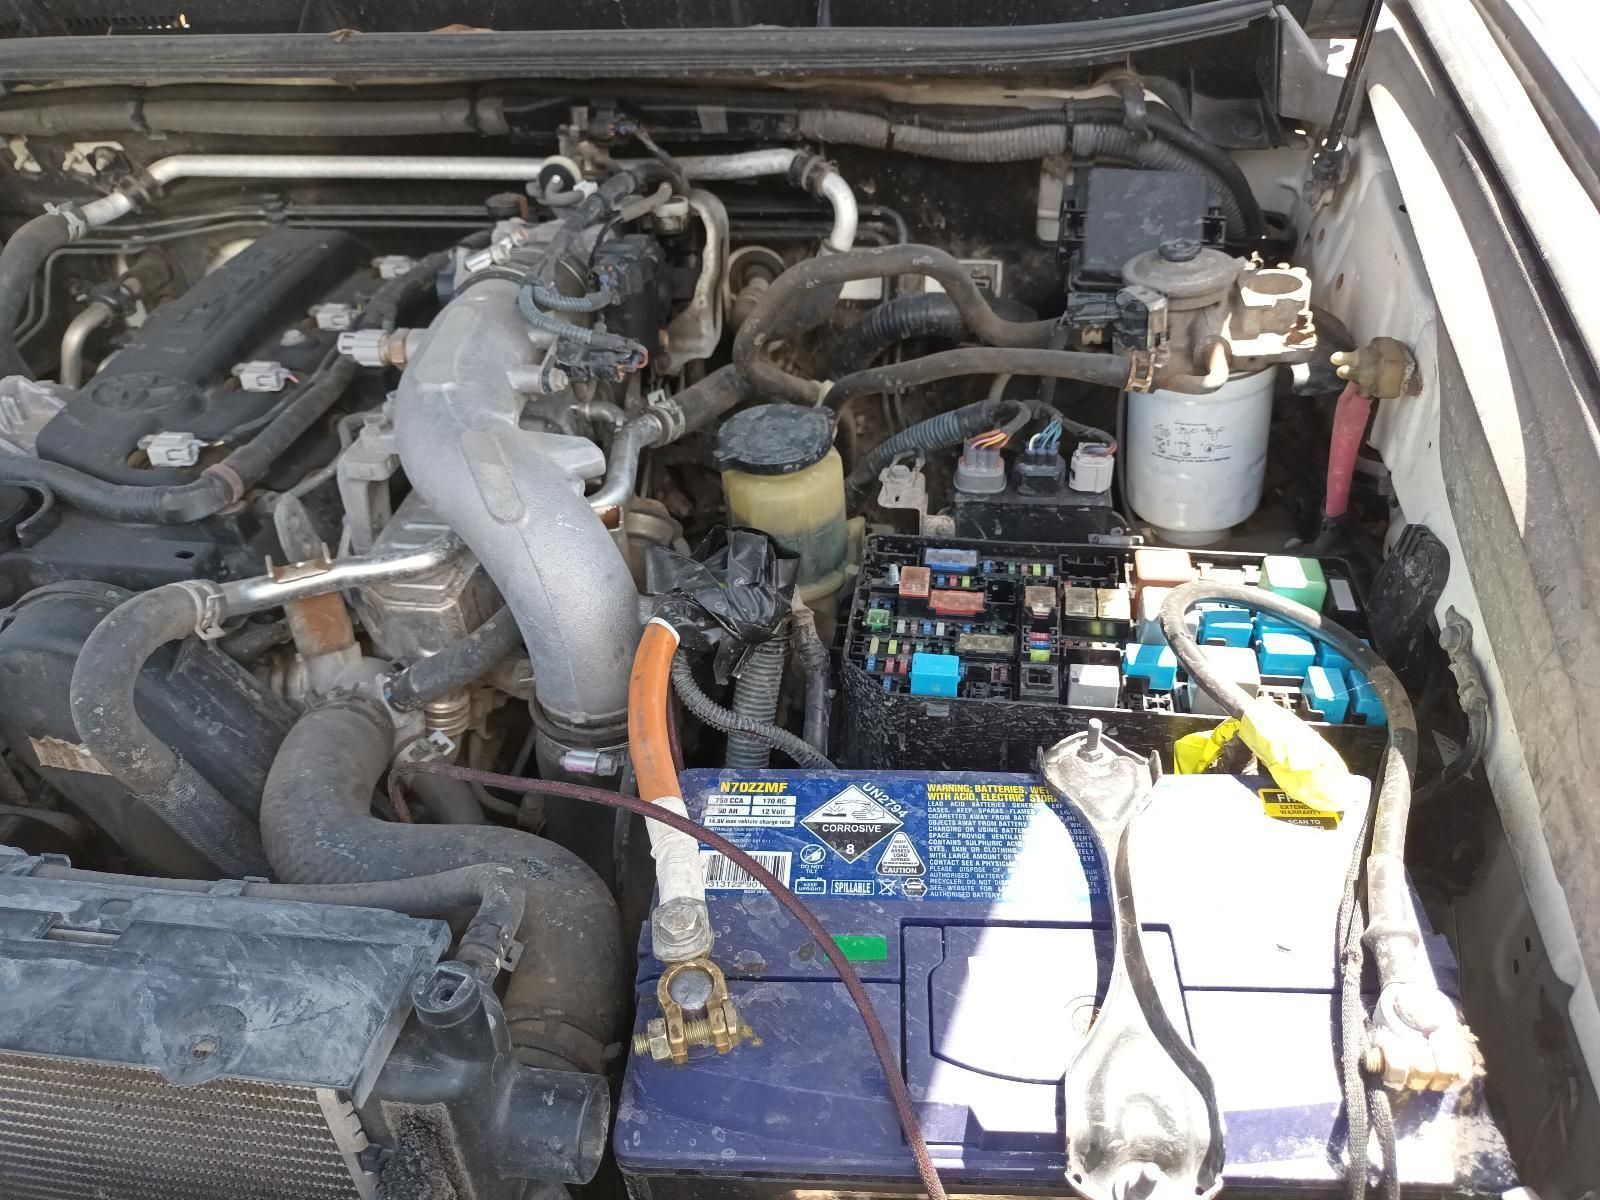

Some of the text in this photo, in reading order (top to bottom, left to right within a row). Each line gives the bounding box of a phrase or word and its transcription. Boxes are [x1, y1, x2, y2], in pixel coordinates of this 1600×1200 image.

[720, 782, 788, 793] N70ZZMF
[927, 784, 973, 792] WARNING:
[862, 782, 908, 818] UN2794
[928, 792, 951, 800] WITH
[822, 824, 881, 832] CORROSIVE
[846, 844, 854, 854] 8
[834, 882, 870, 893] SPILLABLE
